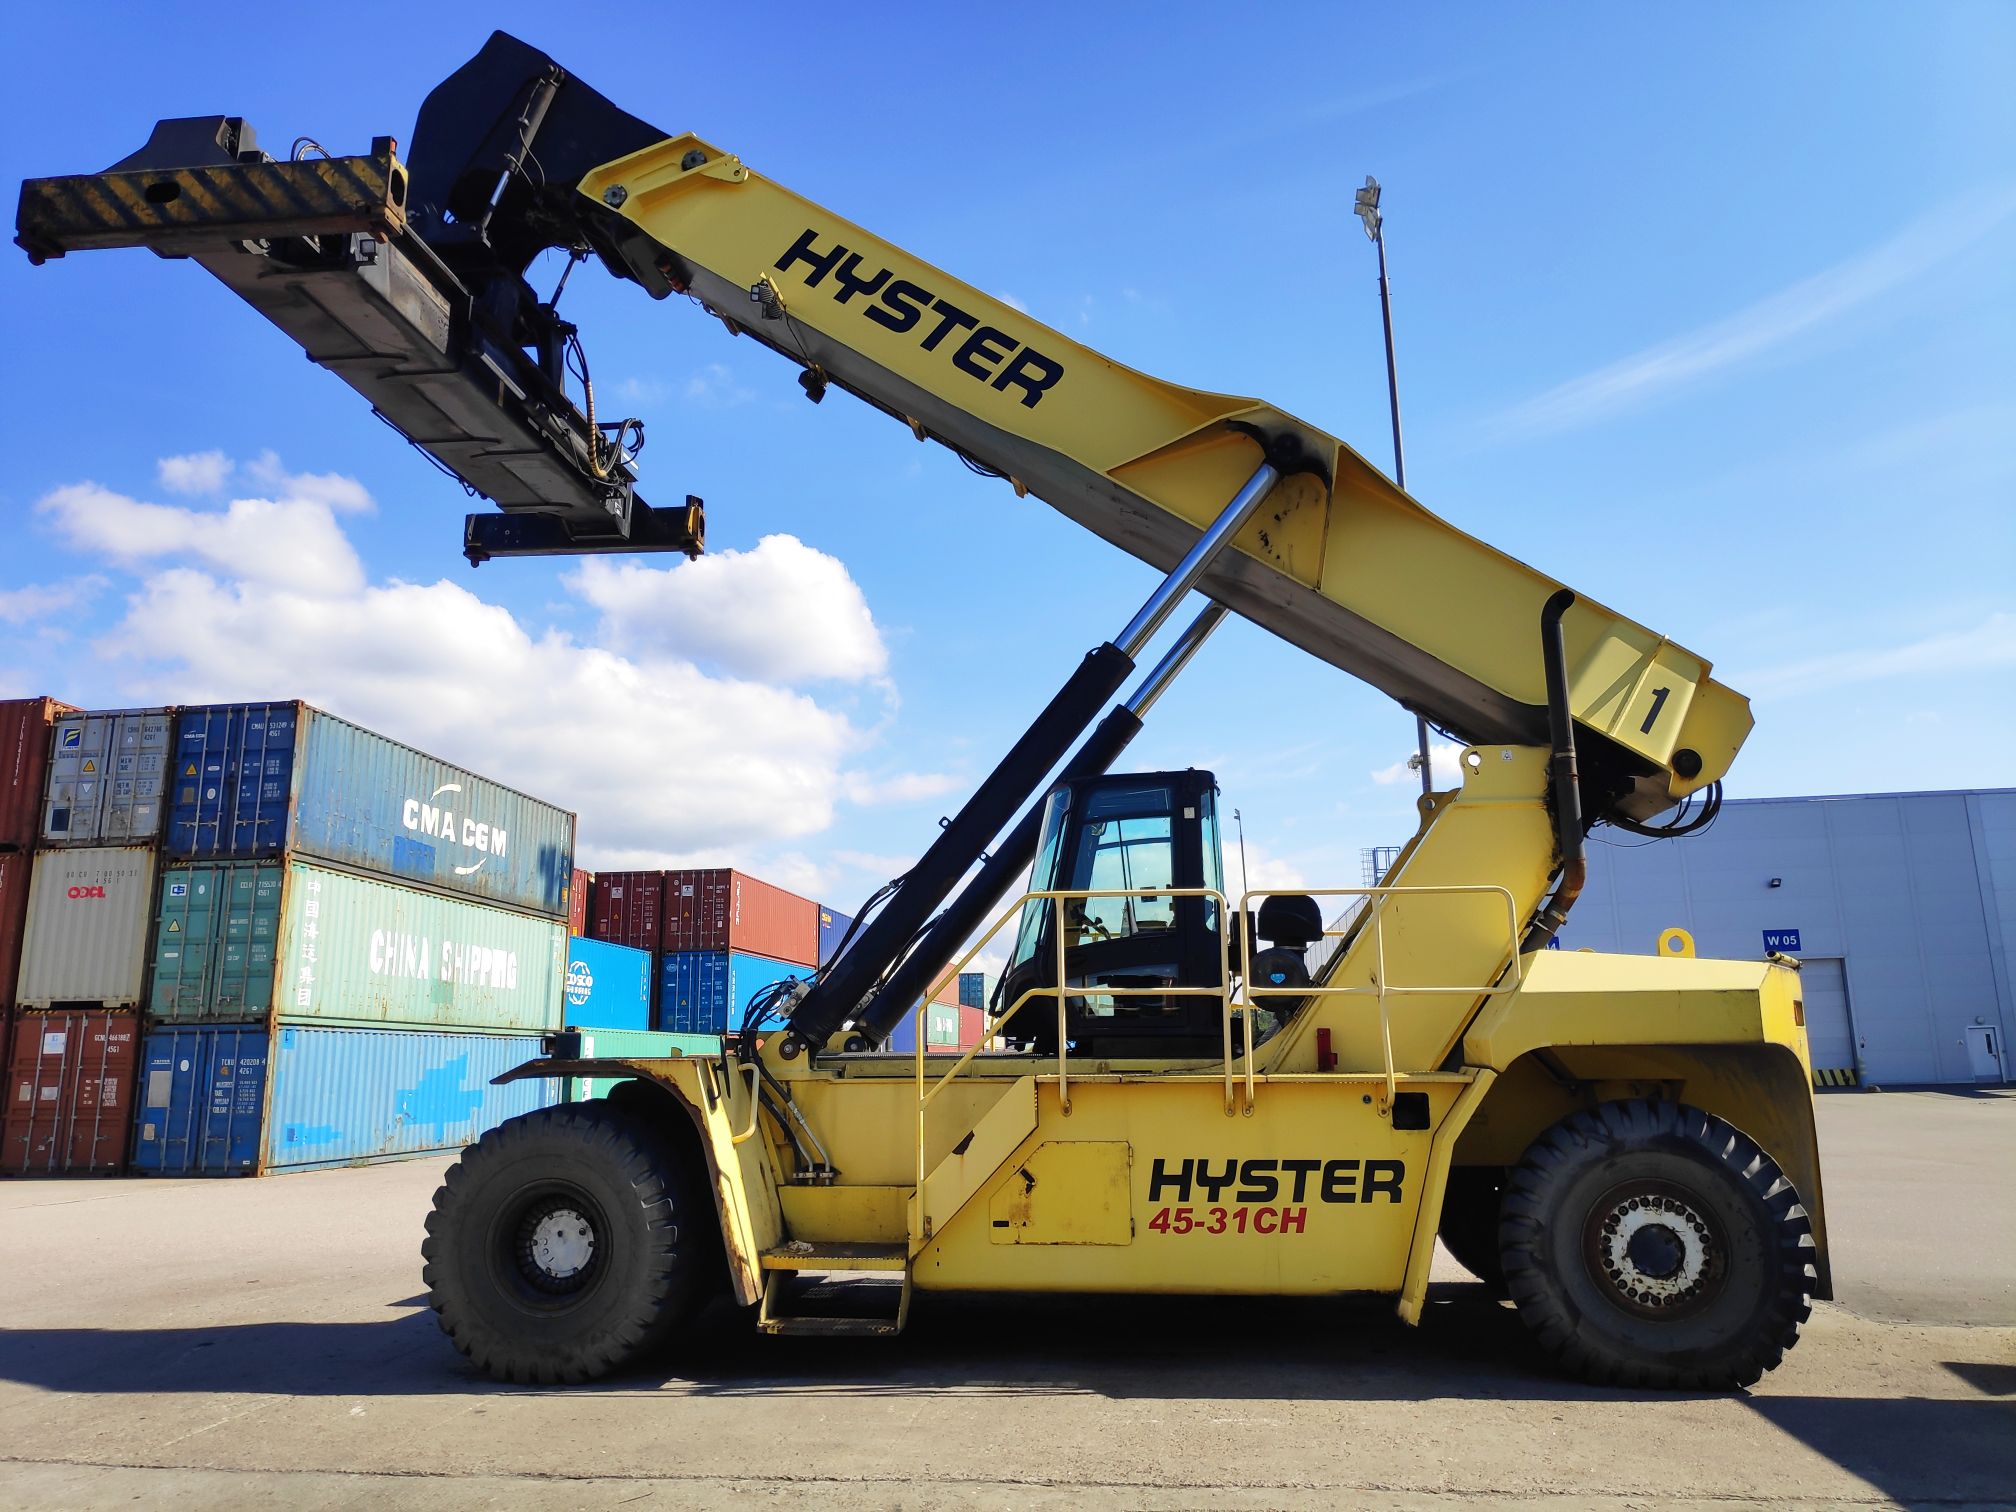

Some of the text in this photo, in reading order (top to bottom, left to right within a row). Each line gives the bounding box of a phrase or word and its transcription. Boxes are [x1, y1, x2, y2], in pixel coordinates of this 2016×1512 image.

[774, 228, 1065, 409] HYSTER
[1640, 687, 1671, 735] 1
[403, 798, 507, 858] CMA CGM
[67, 885, 106, 899] OOCL
[370, 928, 429, 980] CHINA
[441, 940, 518, 990] SHIPPING
[1767, 935, 1797, 946] W 05
[221, 1058, 266, 1066] TCKU 420208 4
[239, 1067, 253, 1075] 42G1
[1148, 1158, 1406, 1204] HYSTER
[1148, 1206, 1308, 1235] 45-31CH
